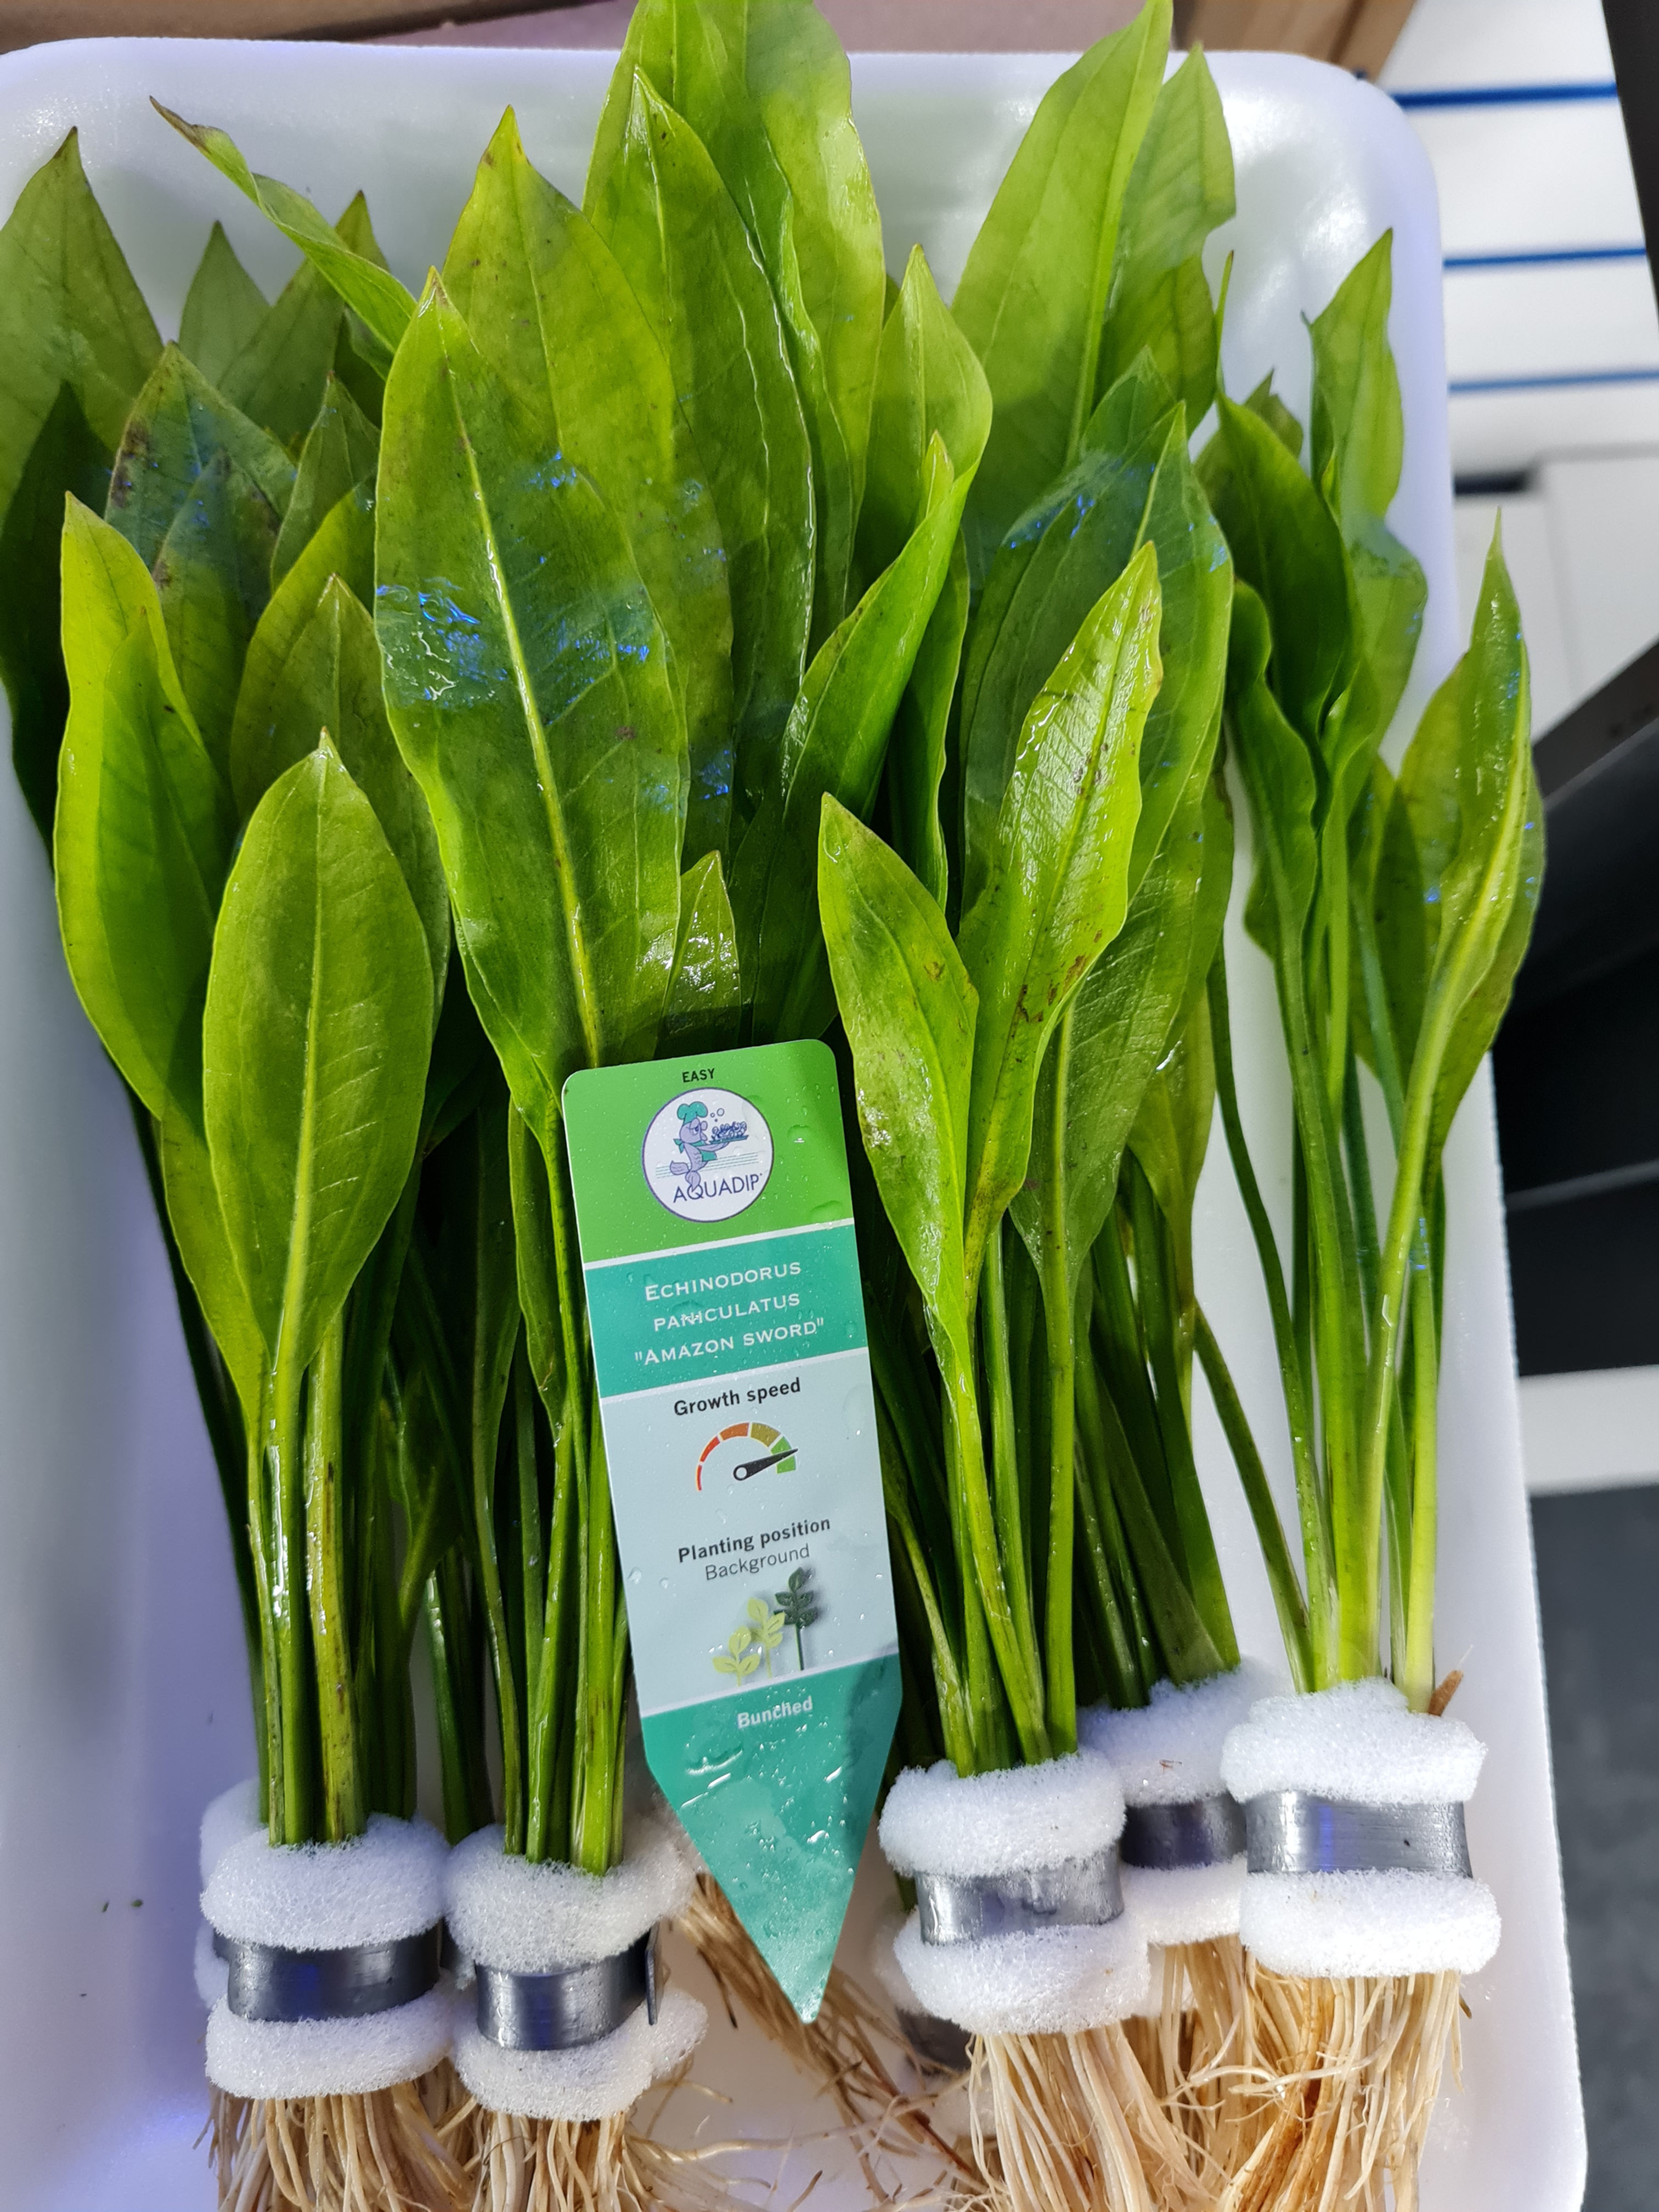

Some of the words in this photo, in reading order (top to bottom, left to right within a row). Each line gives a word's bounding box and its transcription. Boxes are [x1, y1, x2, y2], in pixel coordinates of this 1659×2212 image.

[682, 1068, 715, 1083] EASY
[673, 1173, 760, 1203] AQUADIP
[674, 1391, 741, 1417] Growth
[747, 1377, 802, 1406] speed
[678, 1534, 754, 1563] Planting
[760, 1517, 831, 1548] position
[706, 1543, 810, 1581] Background
[737, 1696, 813, 1729] Bunched
